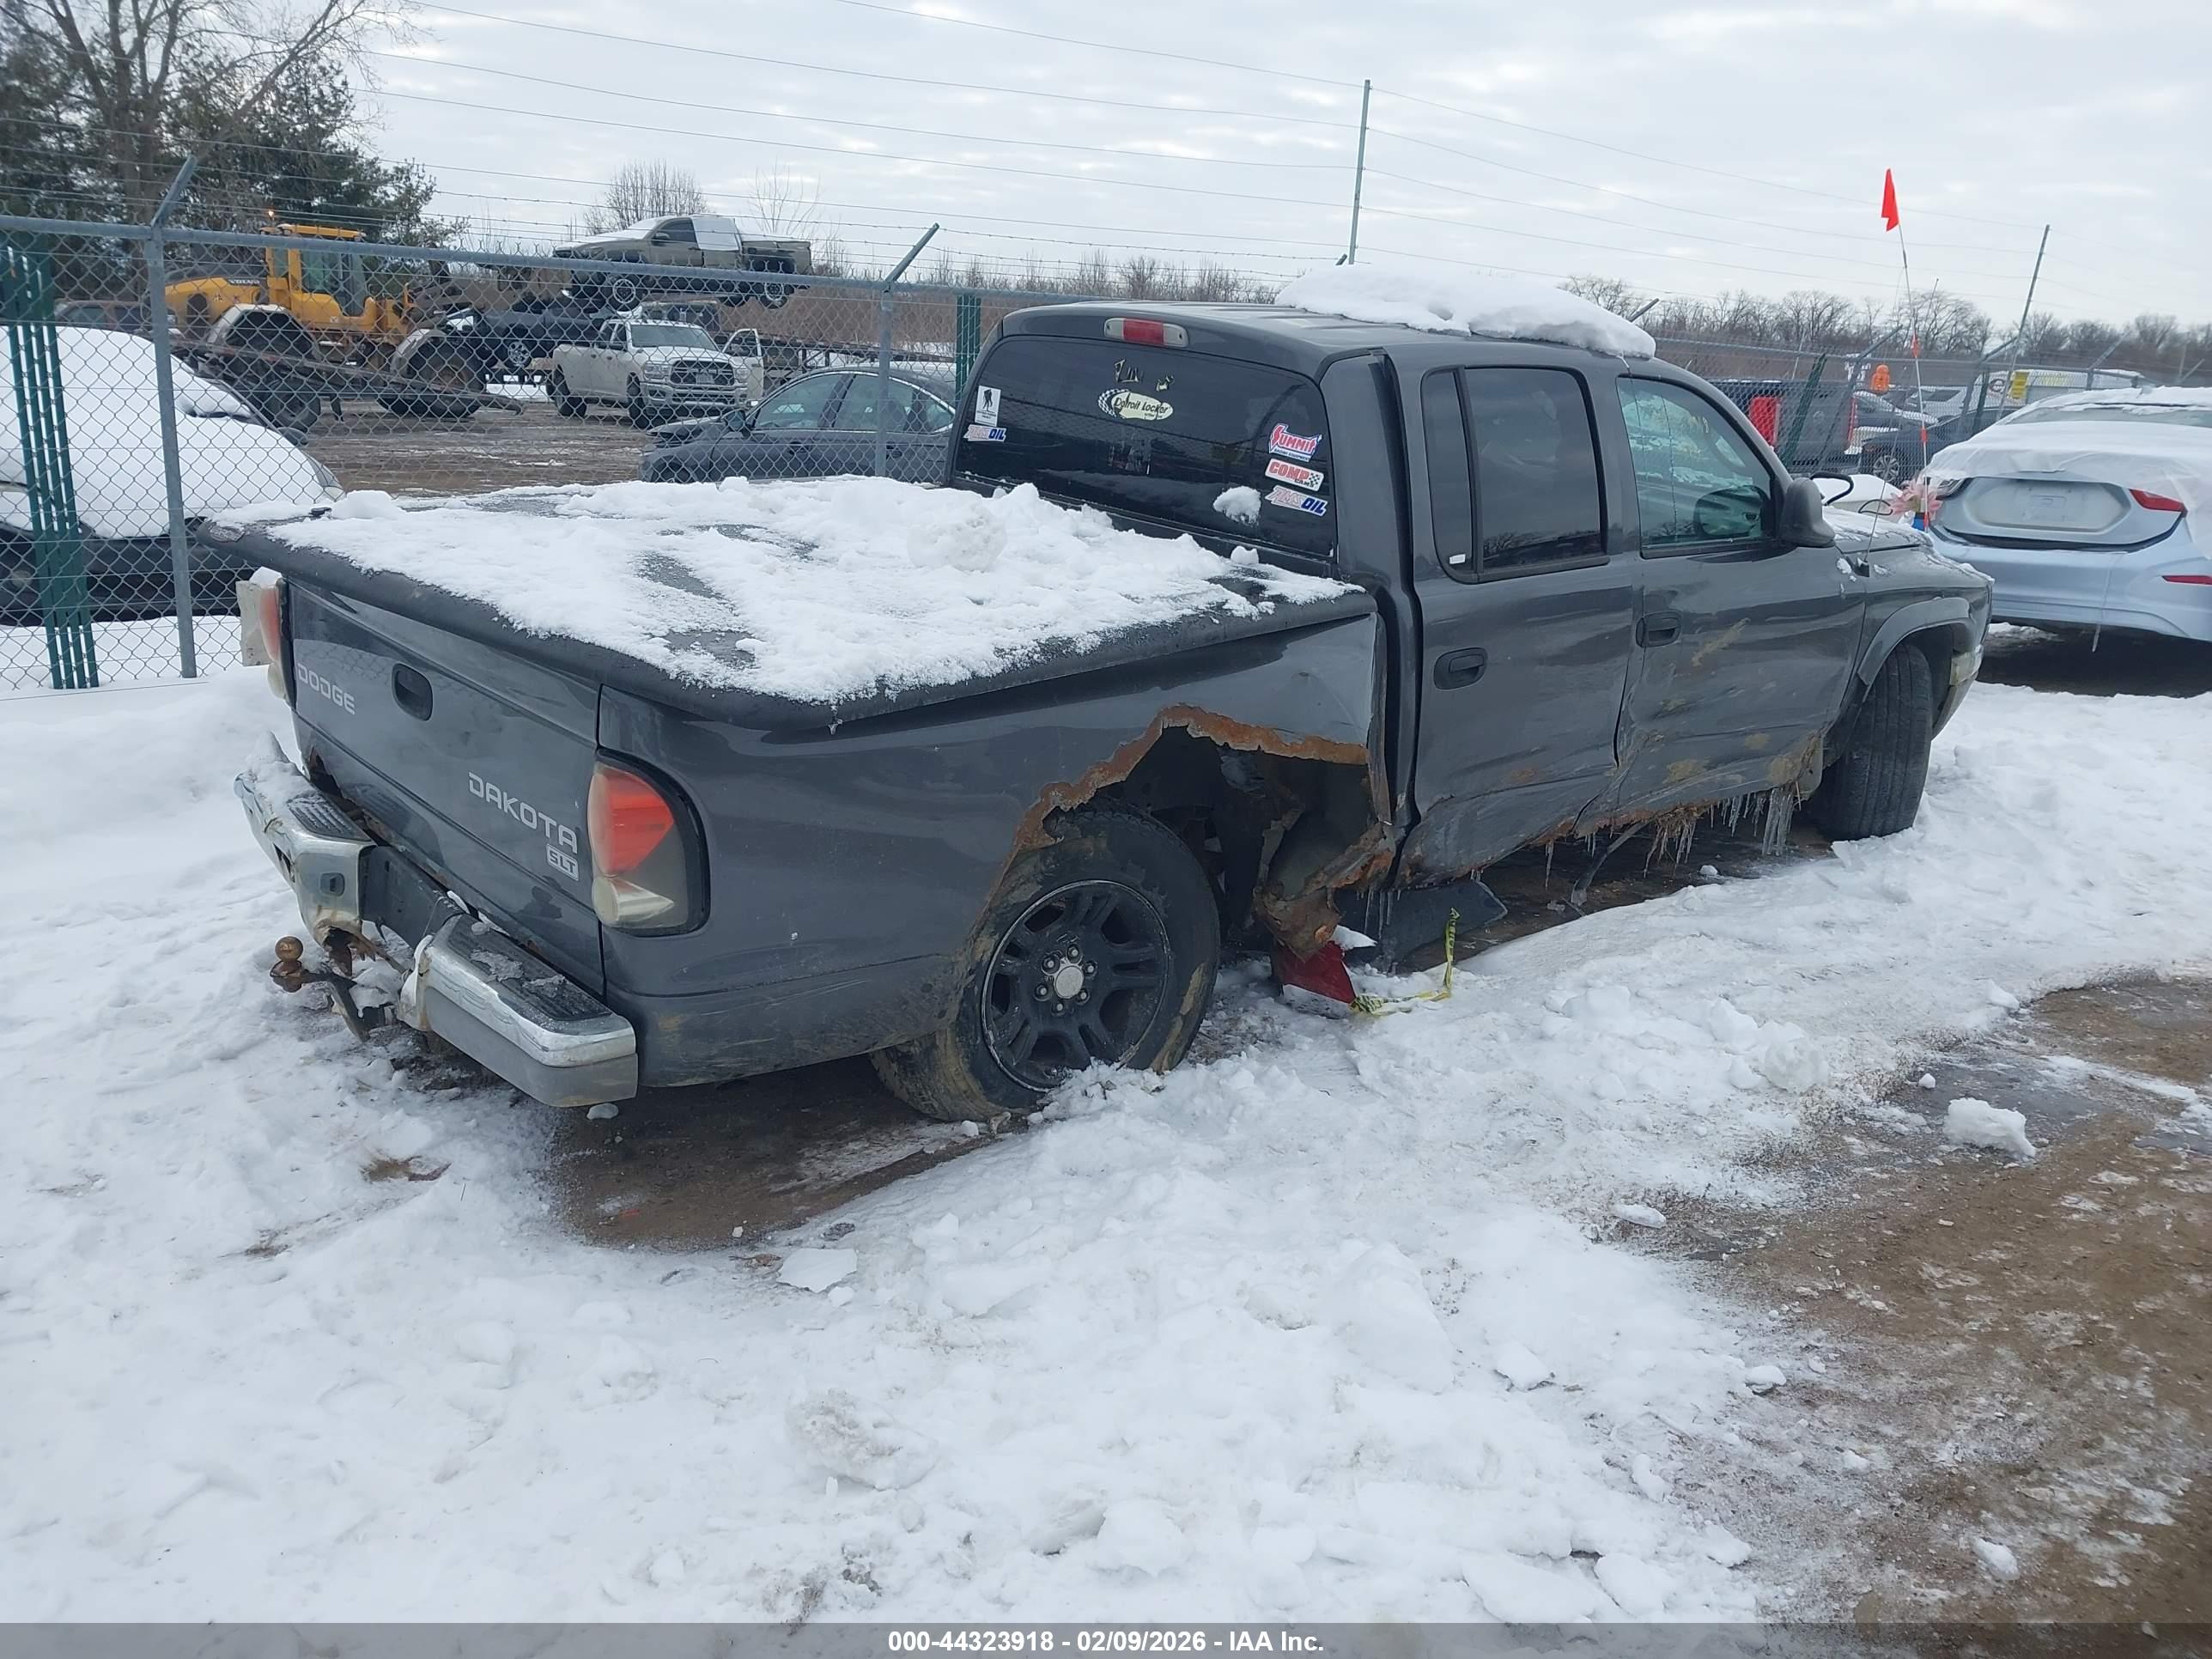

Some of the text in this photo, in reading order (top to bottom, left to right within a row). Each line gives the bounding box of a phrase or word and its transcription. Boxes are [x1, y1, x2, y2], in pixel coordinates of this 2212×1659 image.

[964, 425, 1006, 441] AMSOIL
[1269, 461, 1310, 480] COMP
[1267, 486, 1327, 514] AMSOIL
[297, 663, 356, 715] DODGE
[469, 771, 578, 854] DAKOTA
[548, 846, 578, 876] SLT
